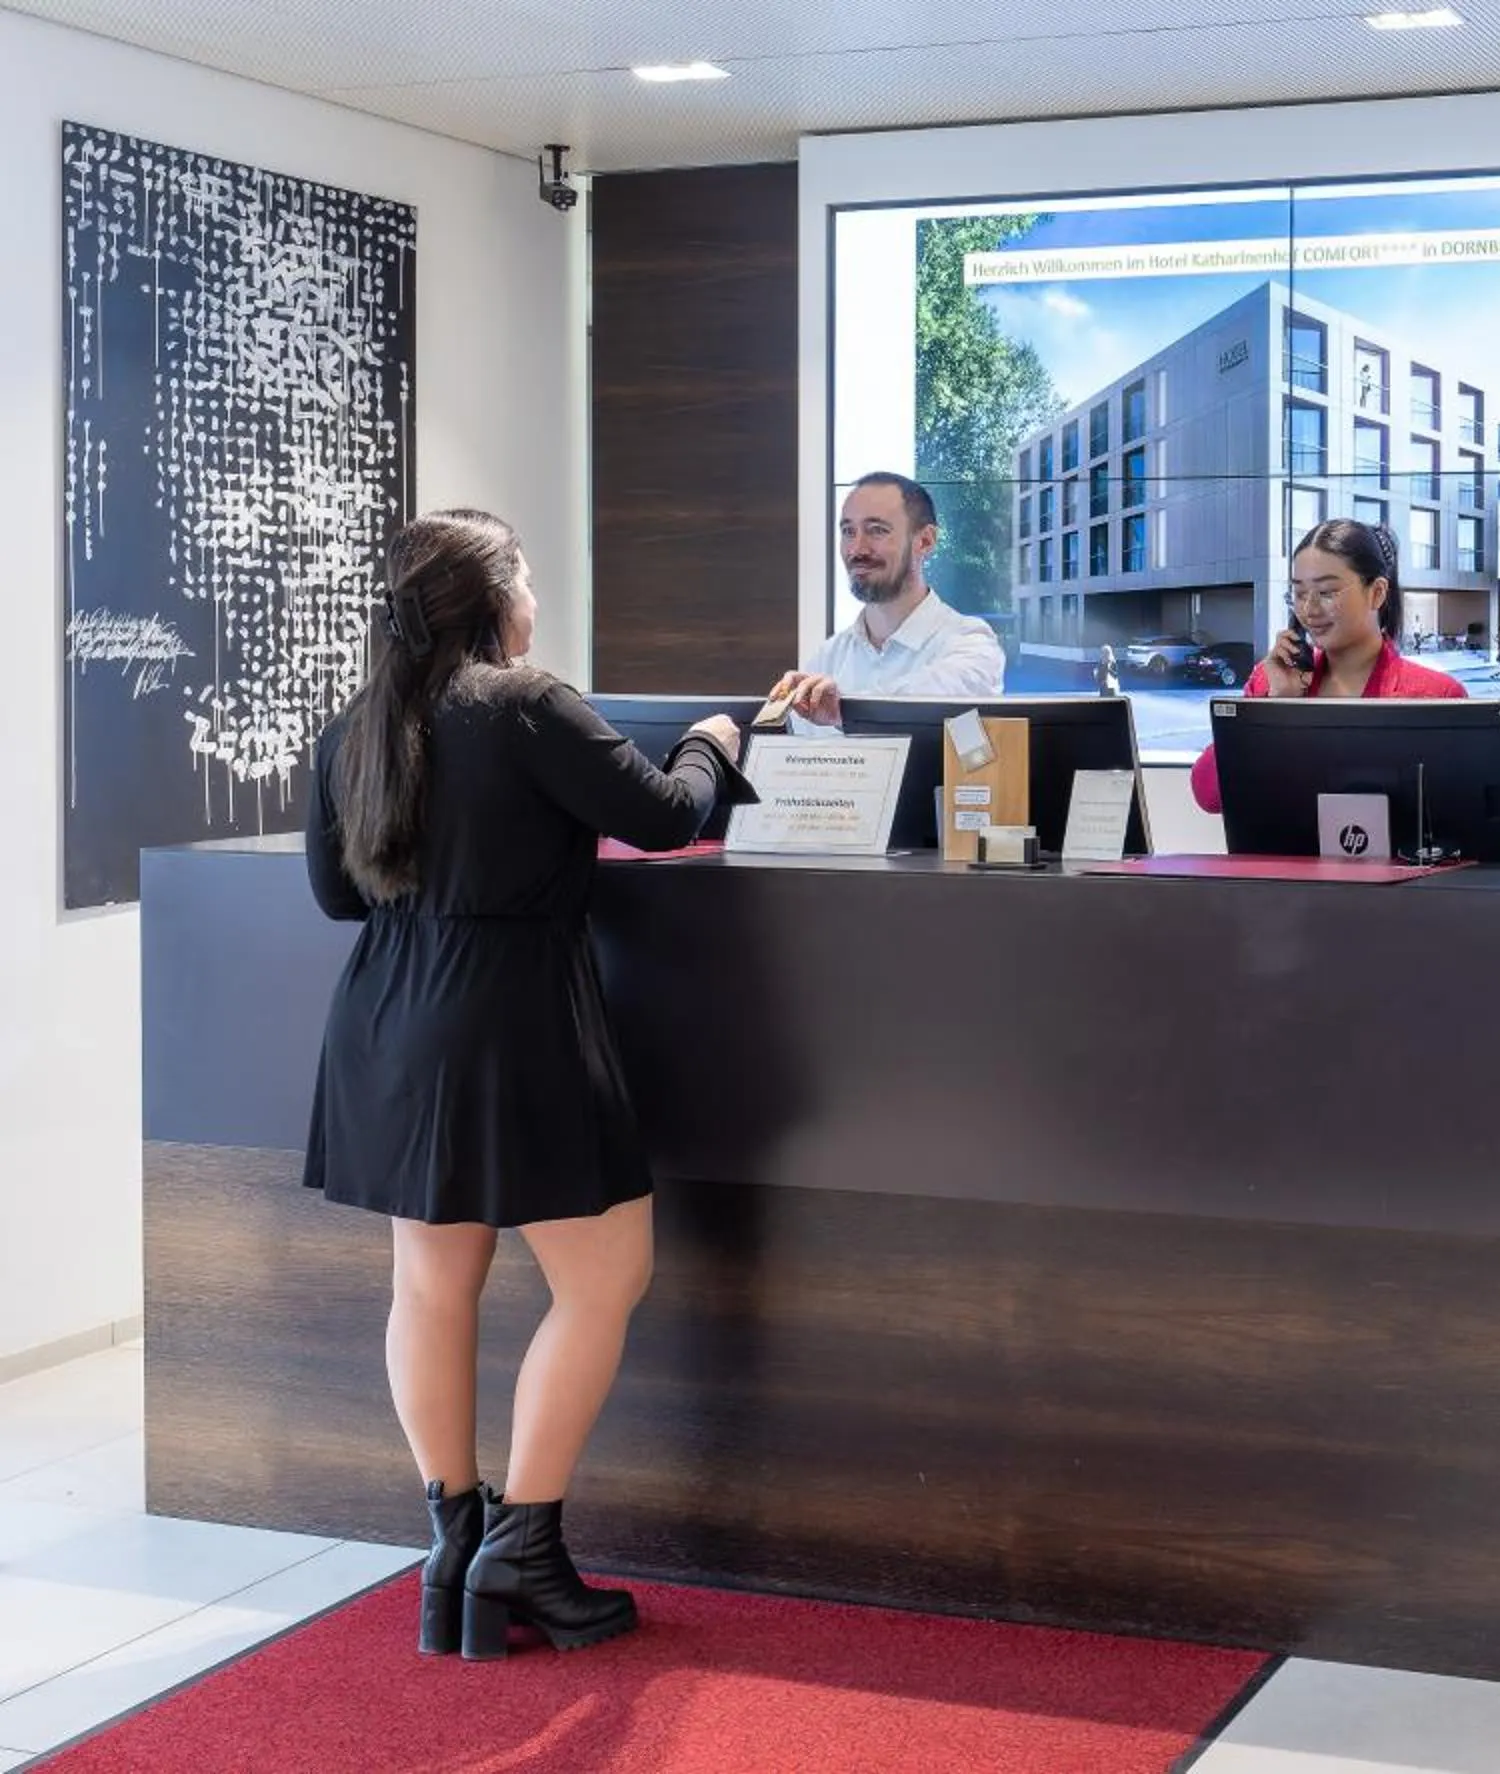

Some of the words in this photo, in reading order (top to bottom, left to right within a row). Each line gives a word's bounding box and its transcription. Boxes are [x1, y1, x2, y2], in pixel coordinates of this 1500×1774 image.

[972, 261, 1029, 277] Herzlich
[1032, 258, 1122, 276] Willkommen
[1127, 254, 1144, 270] im
[1149, 253, 1187, 269] Hotel
[1423, 243, 1437, 257] in
[1343, 825, 1367, 854] hp
